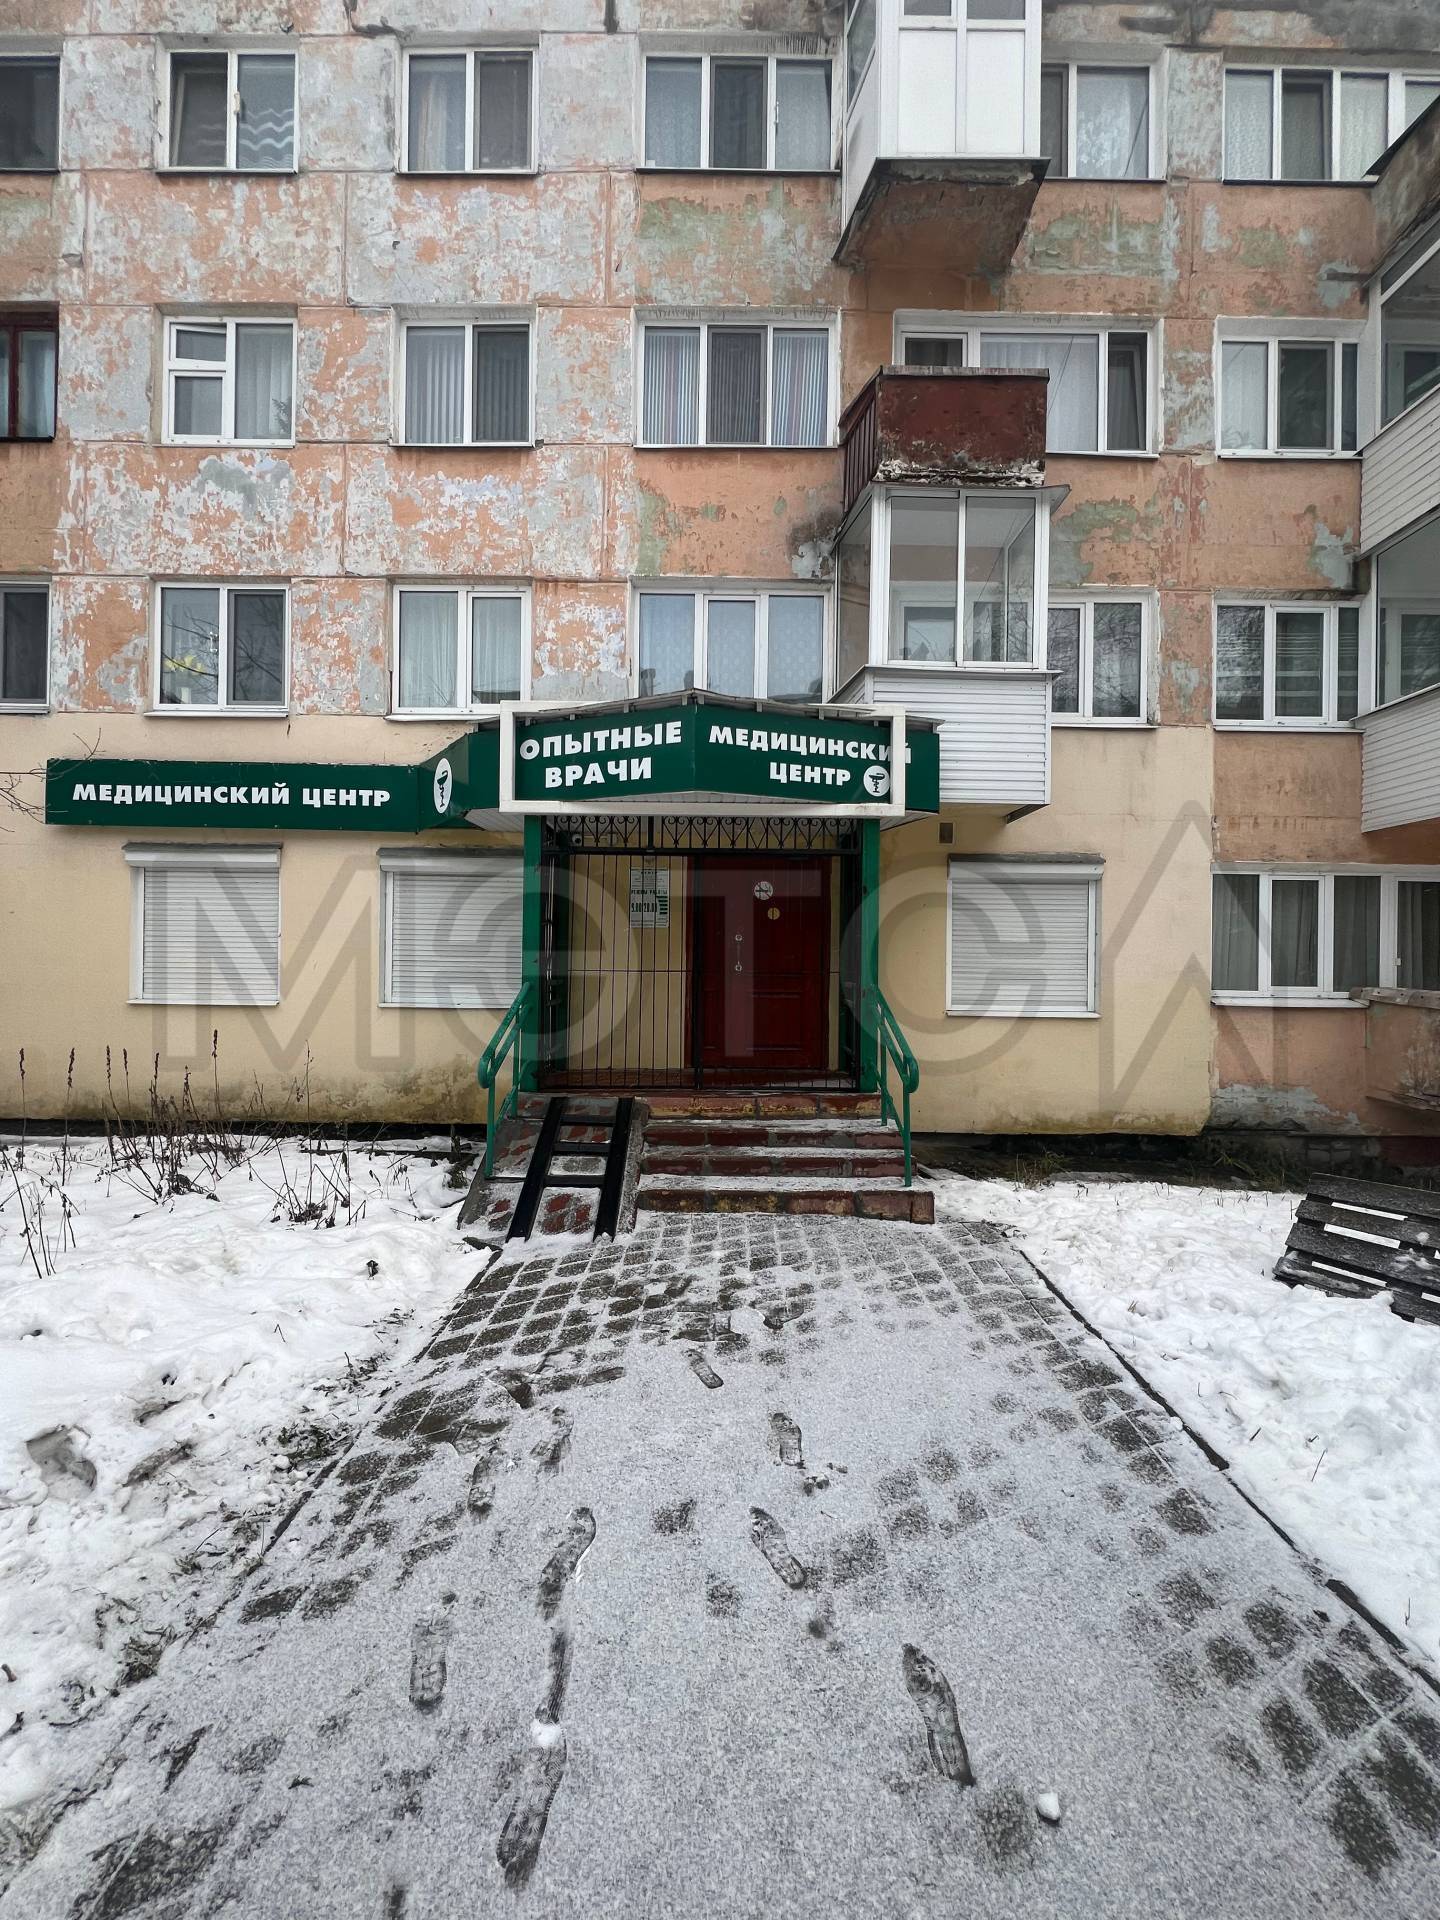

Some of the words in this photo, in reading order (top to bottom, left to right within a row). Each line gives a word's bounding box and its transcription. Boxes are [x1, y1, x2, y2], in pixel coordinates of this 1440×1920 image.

[519, 720, 682, 761] ОПЫТНЫЕ
[545, 757, 652, 789] ВРАЧИ
[769, 762, 851, 786] ЦЕНТР
[72, 782, 290, 805] МЕДИЦИНСКИЙ
[302, 787, 391, 808] ЦЕНТР
